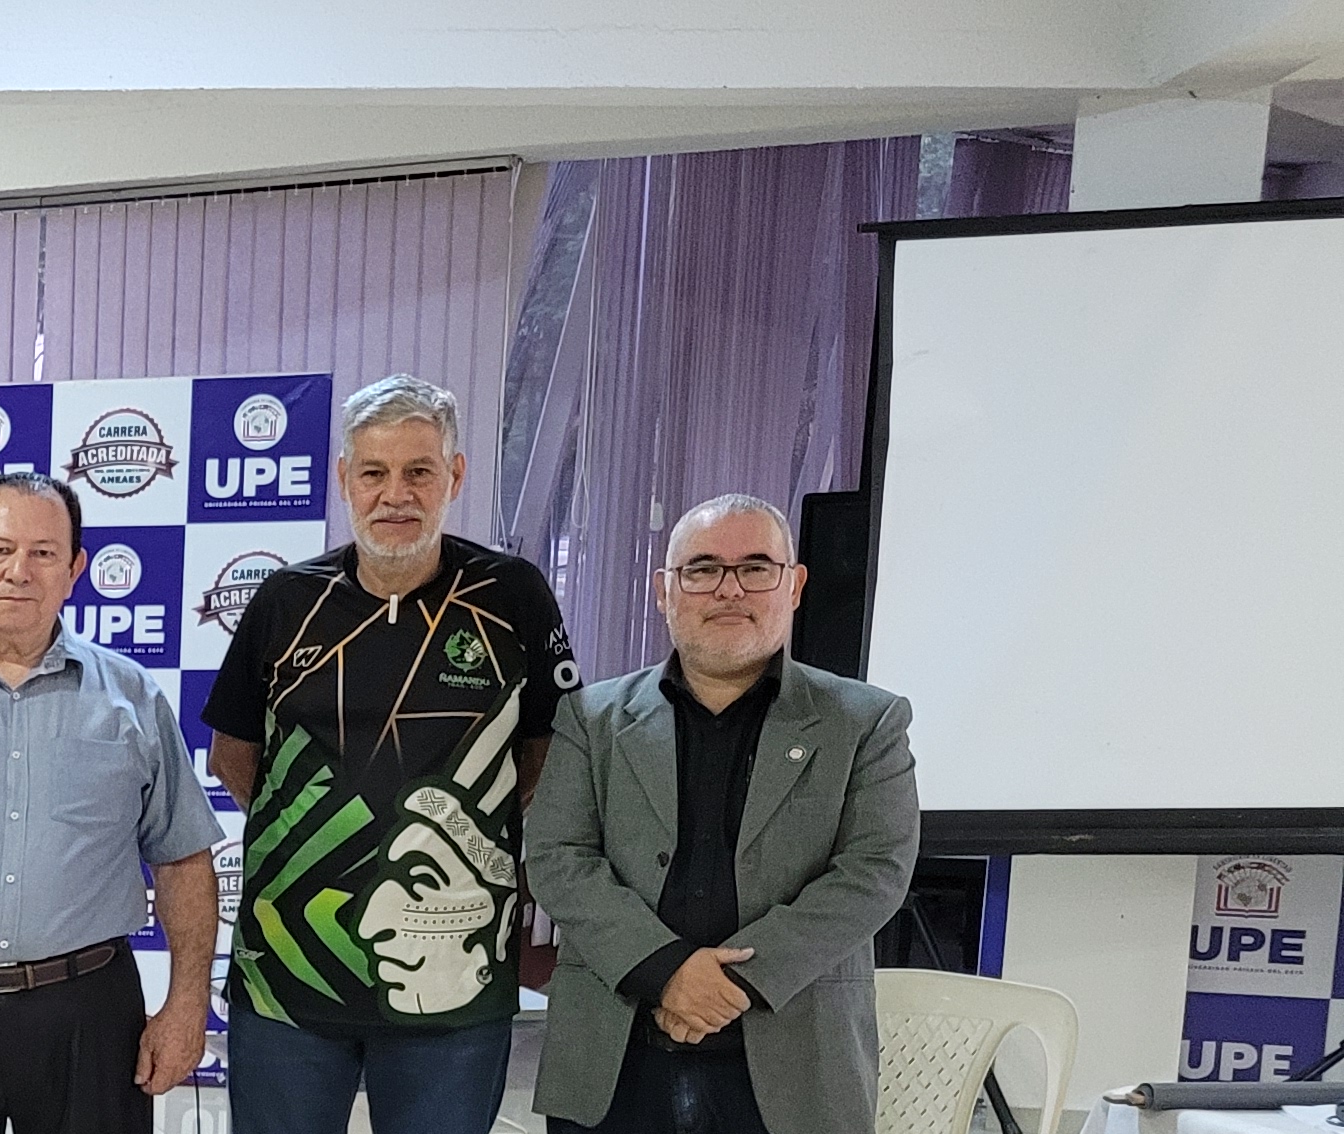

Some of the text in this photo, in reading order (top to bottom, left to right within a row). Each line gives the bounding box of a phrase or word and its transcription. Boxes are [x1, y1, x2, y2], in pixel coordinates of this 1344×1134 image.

[99, 426, 148, 438] CARRERA
[78, 446, 167, 467] ACREDITADA
[205, 455, 312, 499] UPE
[63, 604, 166, 644] UPE
[1189, 925, 1307, 965] UPE
[1179, 1039, 1294, 1082] UPE
